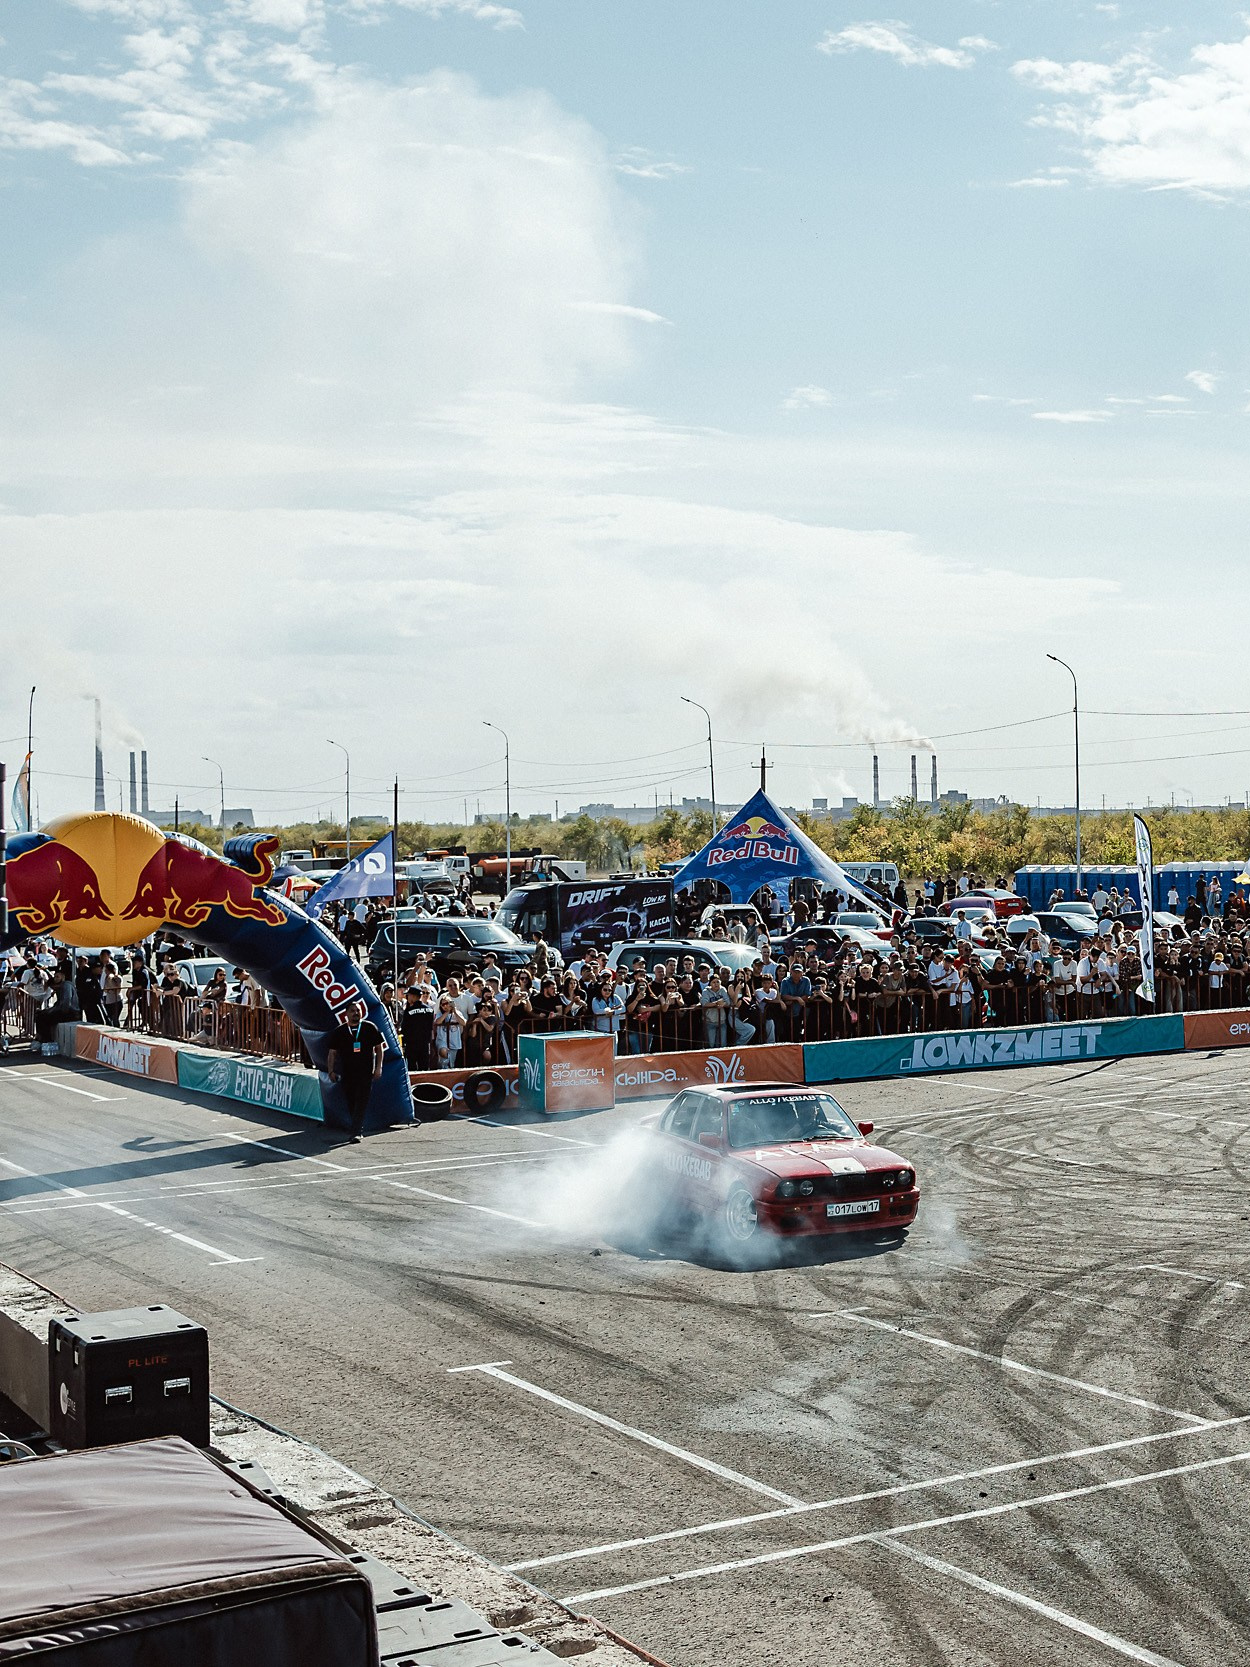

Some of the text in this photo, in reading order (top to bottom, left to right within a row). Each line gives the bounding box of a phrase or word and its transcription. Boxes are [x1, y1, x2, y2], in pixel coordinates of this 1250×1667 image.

[707, 841, 799, 866] Red Bull
[567, 886, 626, 908] DRIFT
[296, 944, 360, 1010] Red
[911, 1026, 1102, 1069] LOWKZMEET
[128, 1355, 168, 1368] PL LITE
